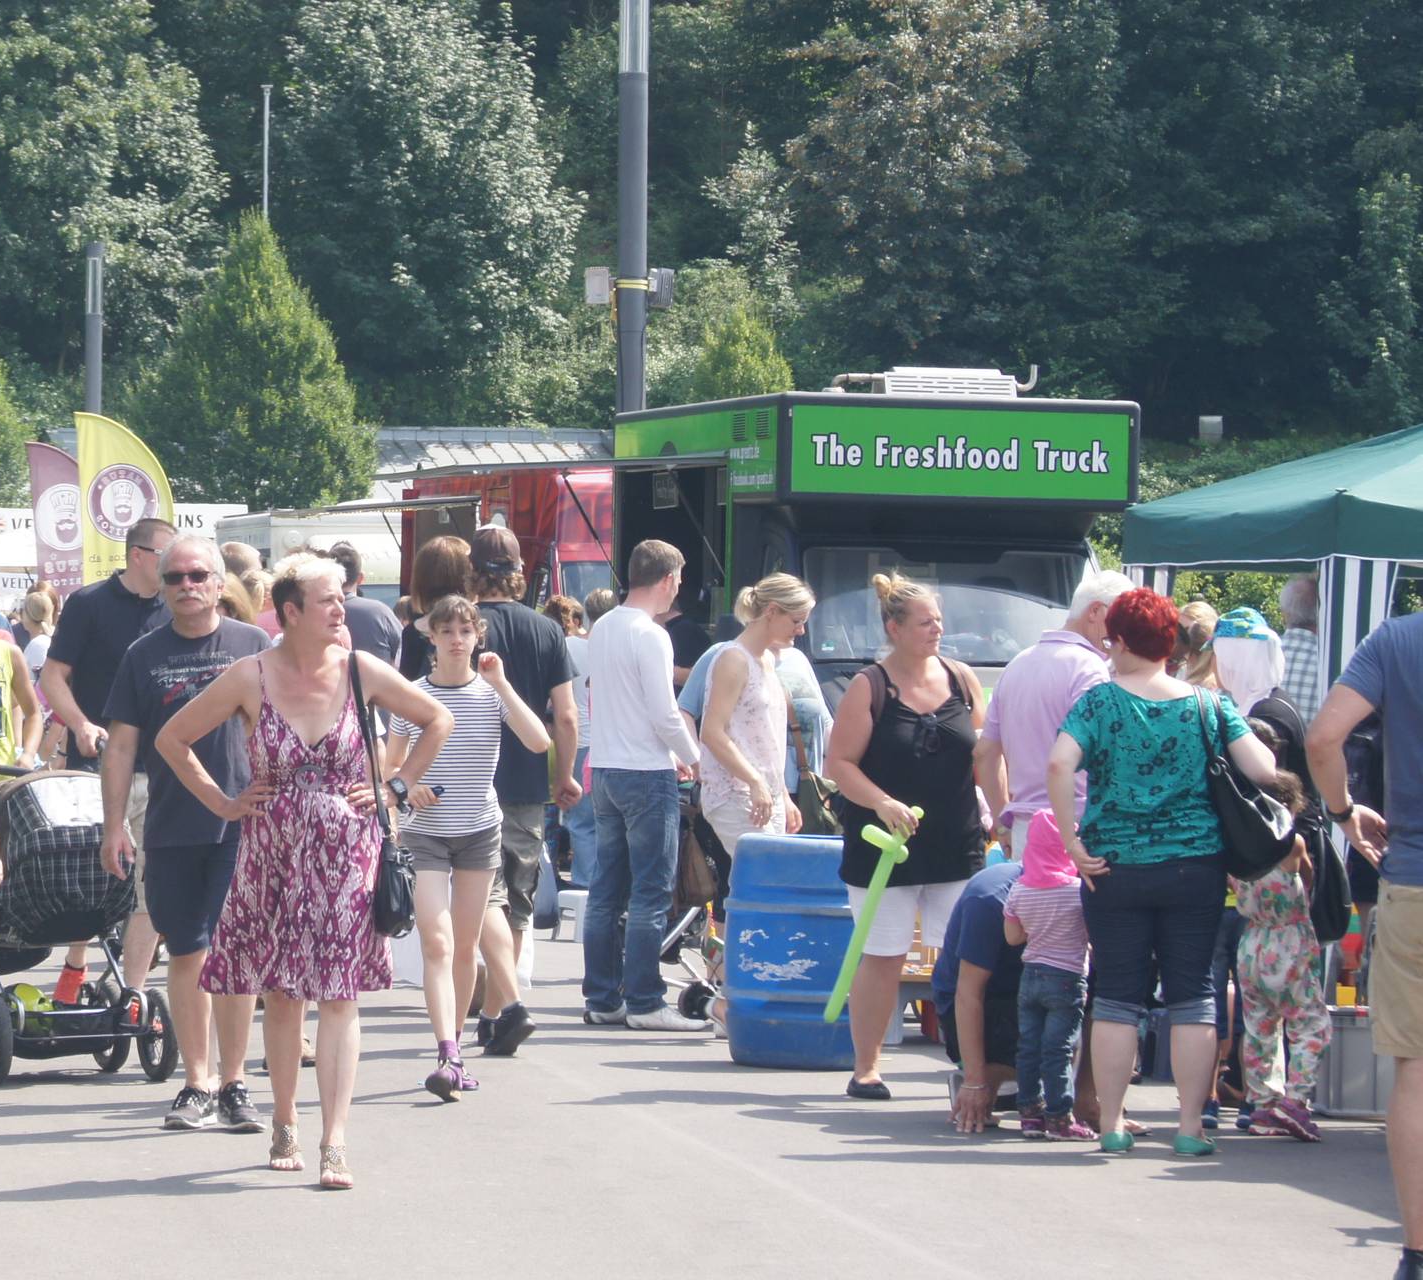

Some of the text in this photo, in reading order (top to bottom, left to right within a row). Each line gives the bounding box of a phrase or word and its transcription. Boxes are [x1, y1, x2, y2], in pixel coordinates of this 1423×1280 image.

[811, 433, 1110, 473] The Freshfood Truck
